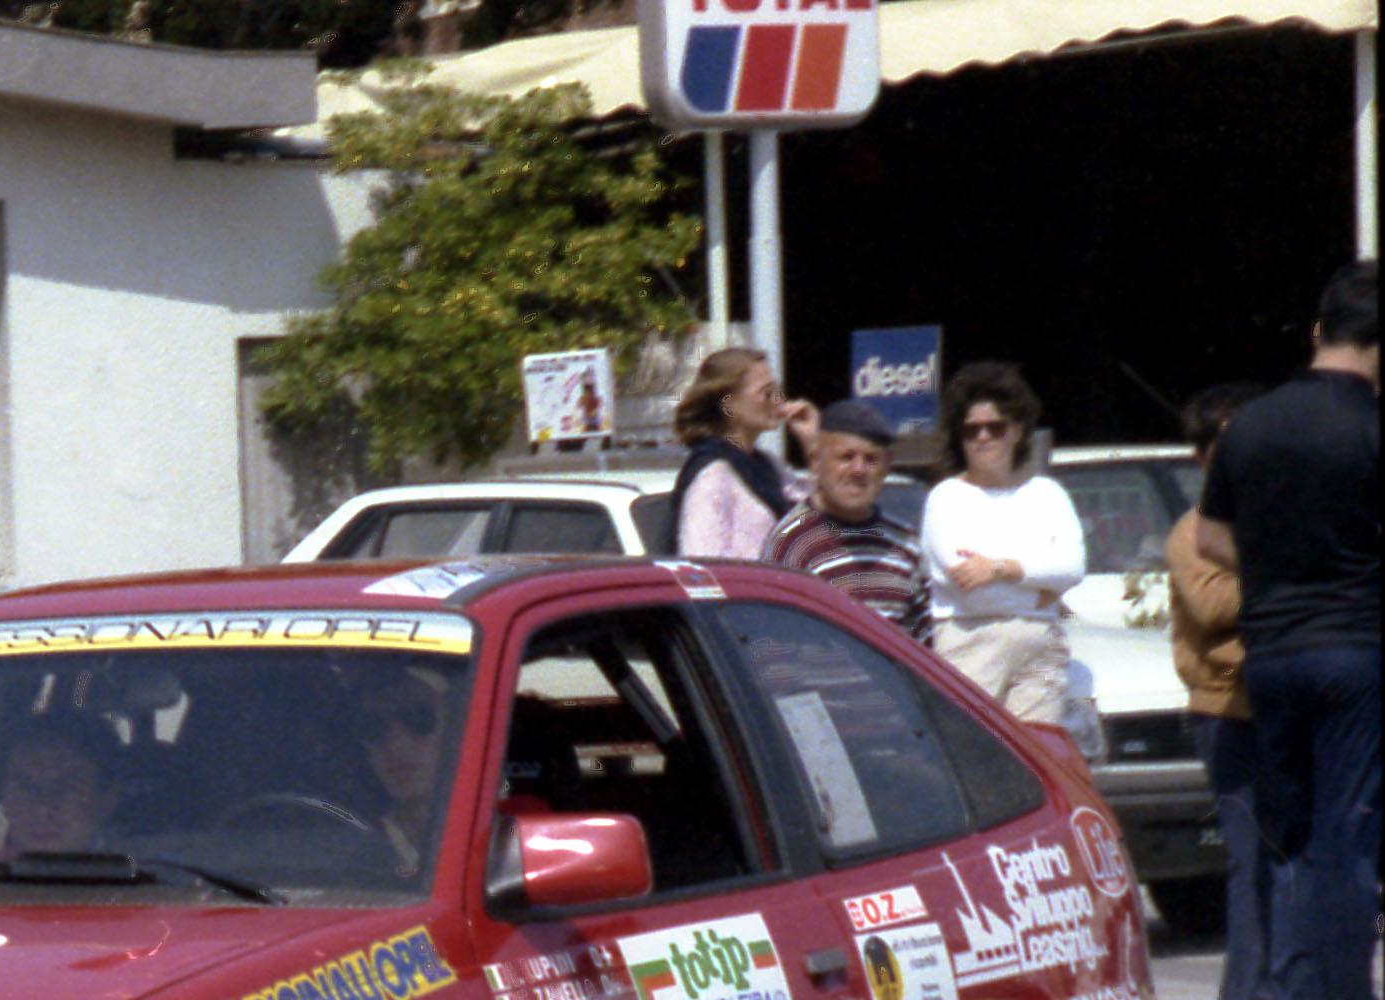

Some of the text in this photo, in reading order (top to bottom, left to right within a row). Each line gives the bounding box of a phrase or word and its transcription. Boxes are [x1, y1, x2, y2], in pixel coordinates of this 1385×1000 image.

[854, 352, 936, 397] diesel
[284, 616, 442, 645] OPEL
[986, 837, 1071, 886] Centro
[372, 928, 455, 1000] OPEL
[668, 928, 750, 1000] totip
